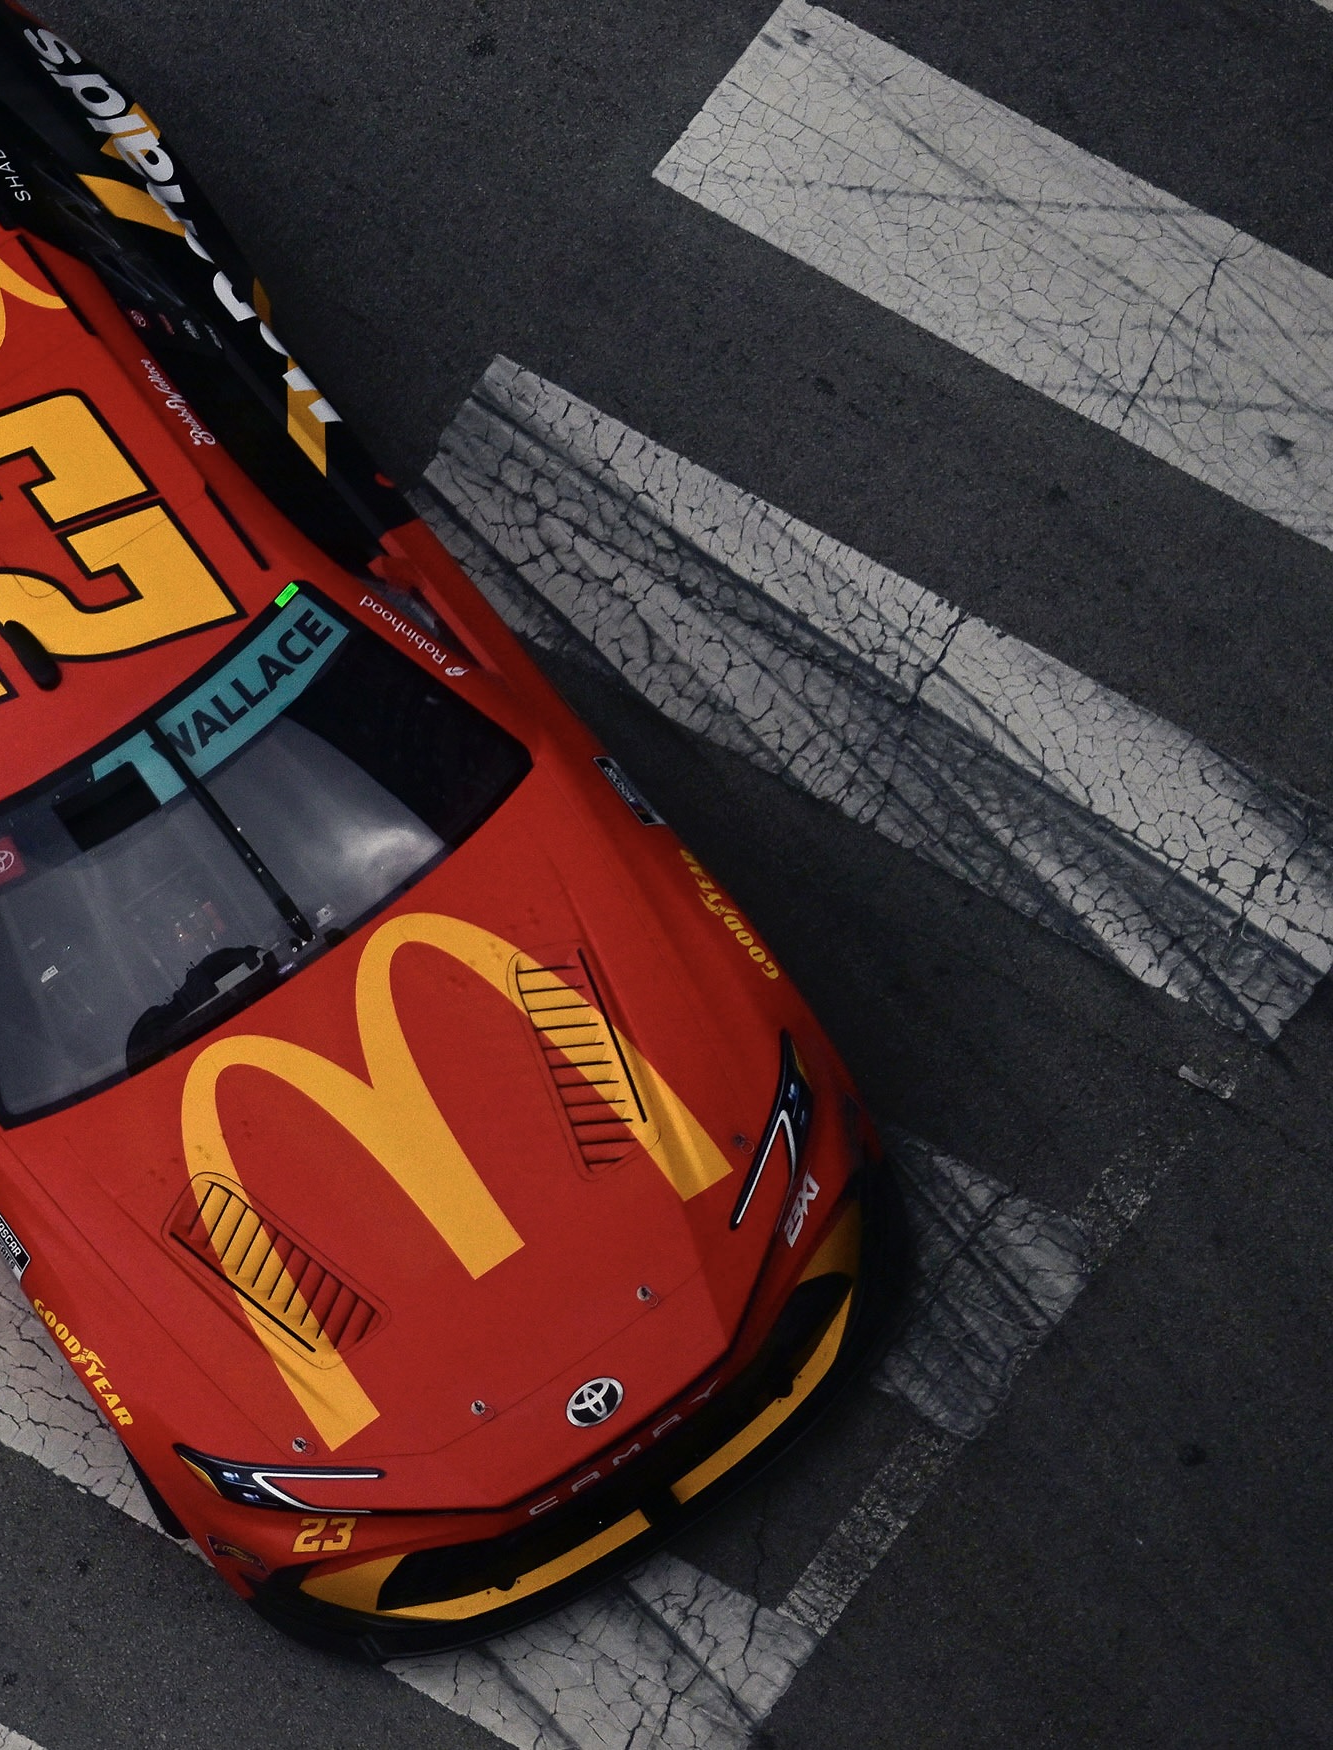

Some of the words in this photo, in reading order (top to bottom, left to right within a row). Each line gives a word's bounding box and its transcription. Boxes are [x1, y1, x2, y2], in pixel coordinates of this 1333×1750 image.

[359, 595, 447, 664] Robinhood
[679, 848, 779, 980] GOODYEAR
[34, 1298, 134, 1426] GOODYEAR
[292, 1518, 358, 1553] 23
